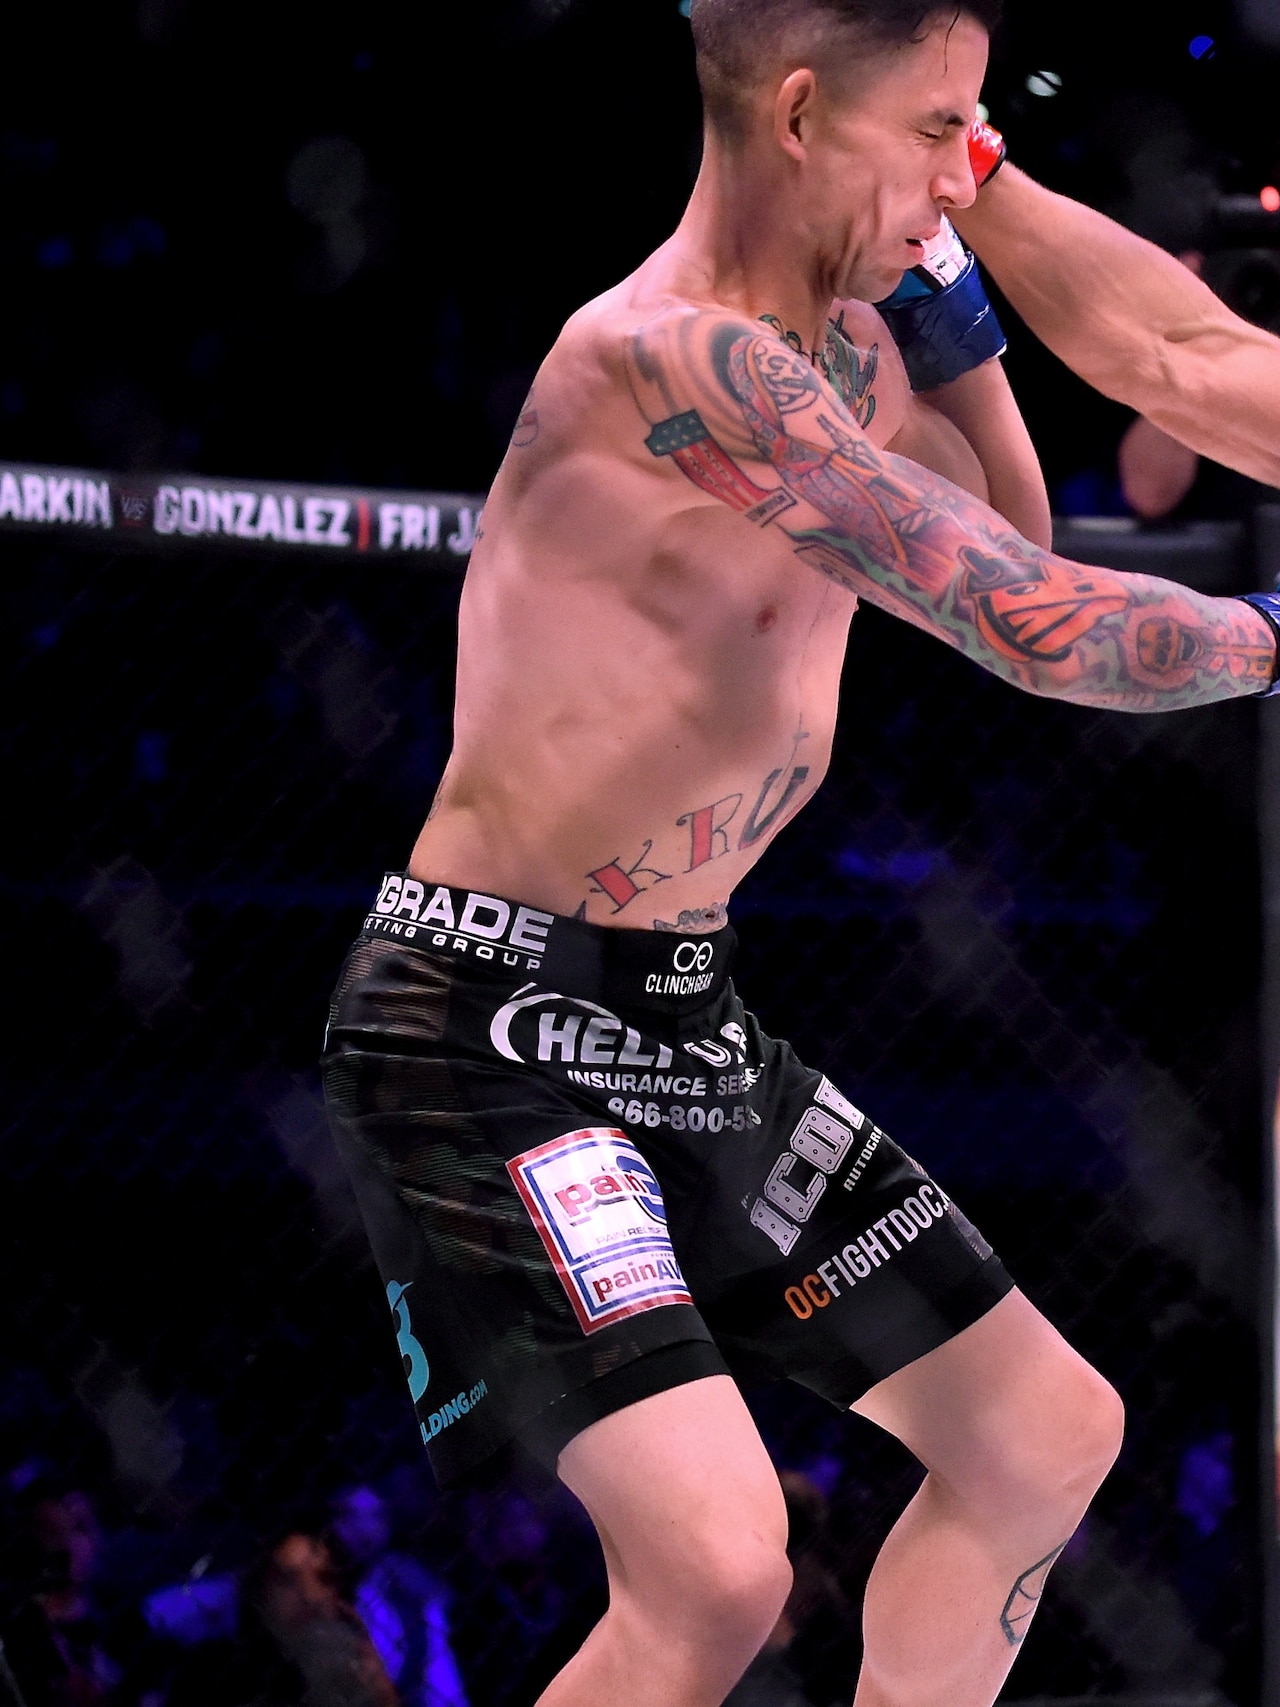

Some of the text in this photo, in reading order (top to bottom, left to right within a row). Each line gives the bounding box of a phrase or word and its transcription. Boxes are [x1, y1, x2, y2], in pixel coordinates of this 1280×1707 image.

[0, 472, 112, 528] ARKIN
[153, 486, 352, 548] GONZALEZ
[379, 502, 440, 551] FRI
[363, 917, 542, 971] ETING GROUP
[376, 875, 555, 953] GRADE
[567, 1069, 706, 1096] INSURANCE
[554, 1166, 648, 1219] pain
[784, 1184, 950, 1320] OCFIGHTDOC.
[420, 1379, 489, 1446] LDING.COM
